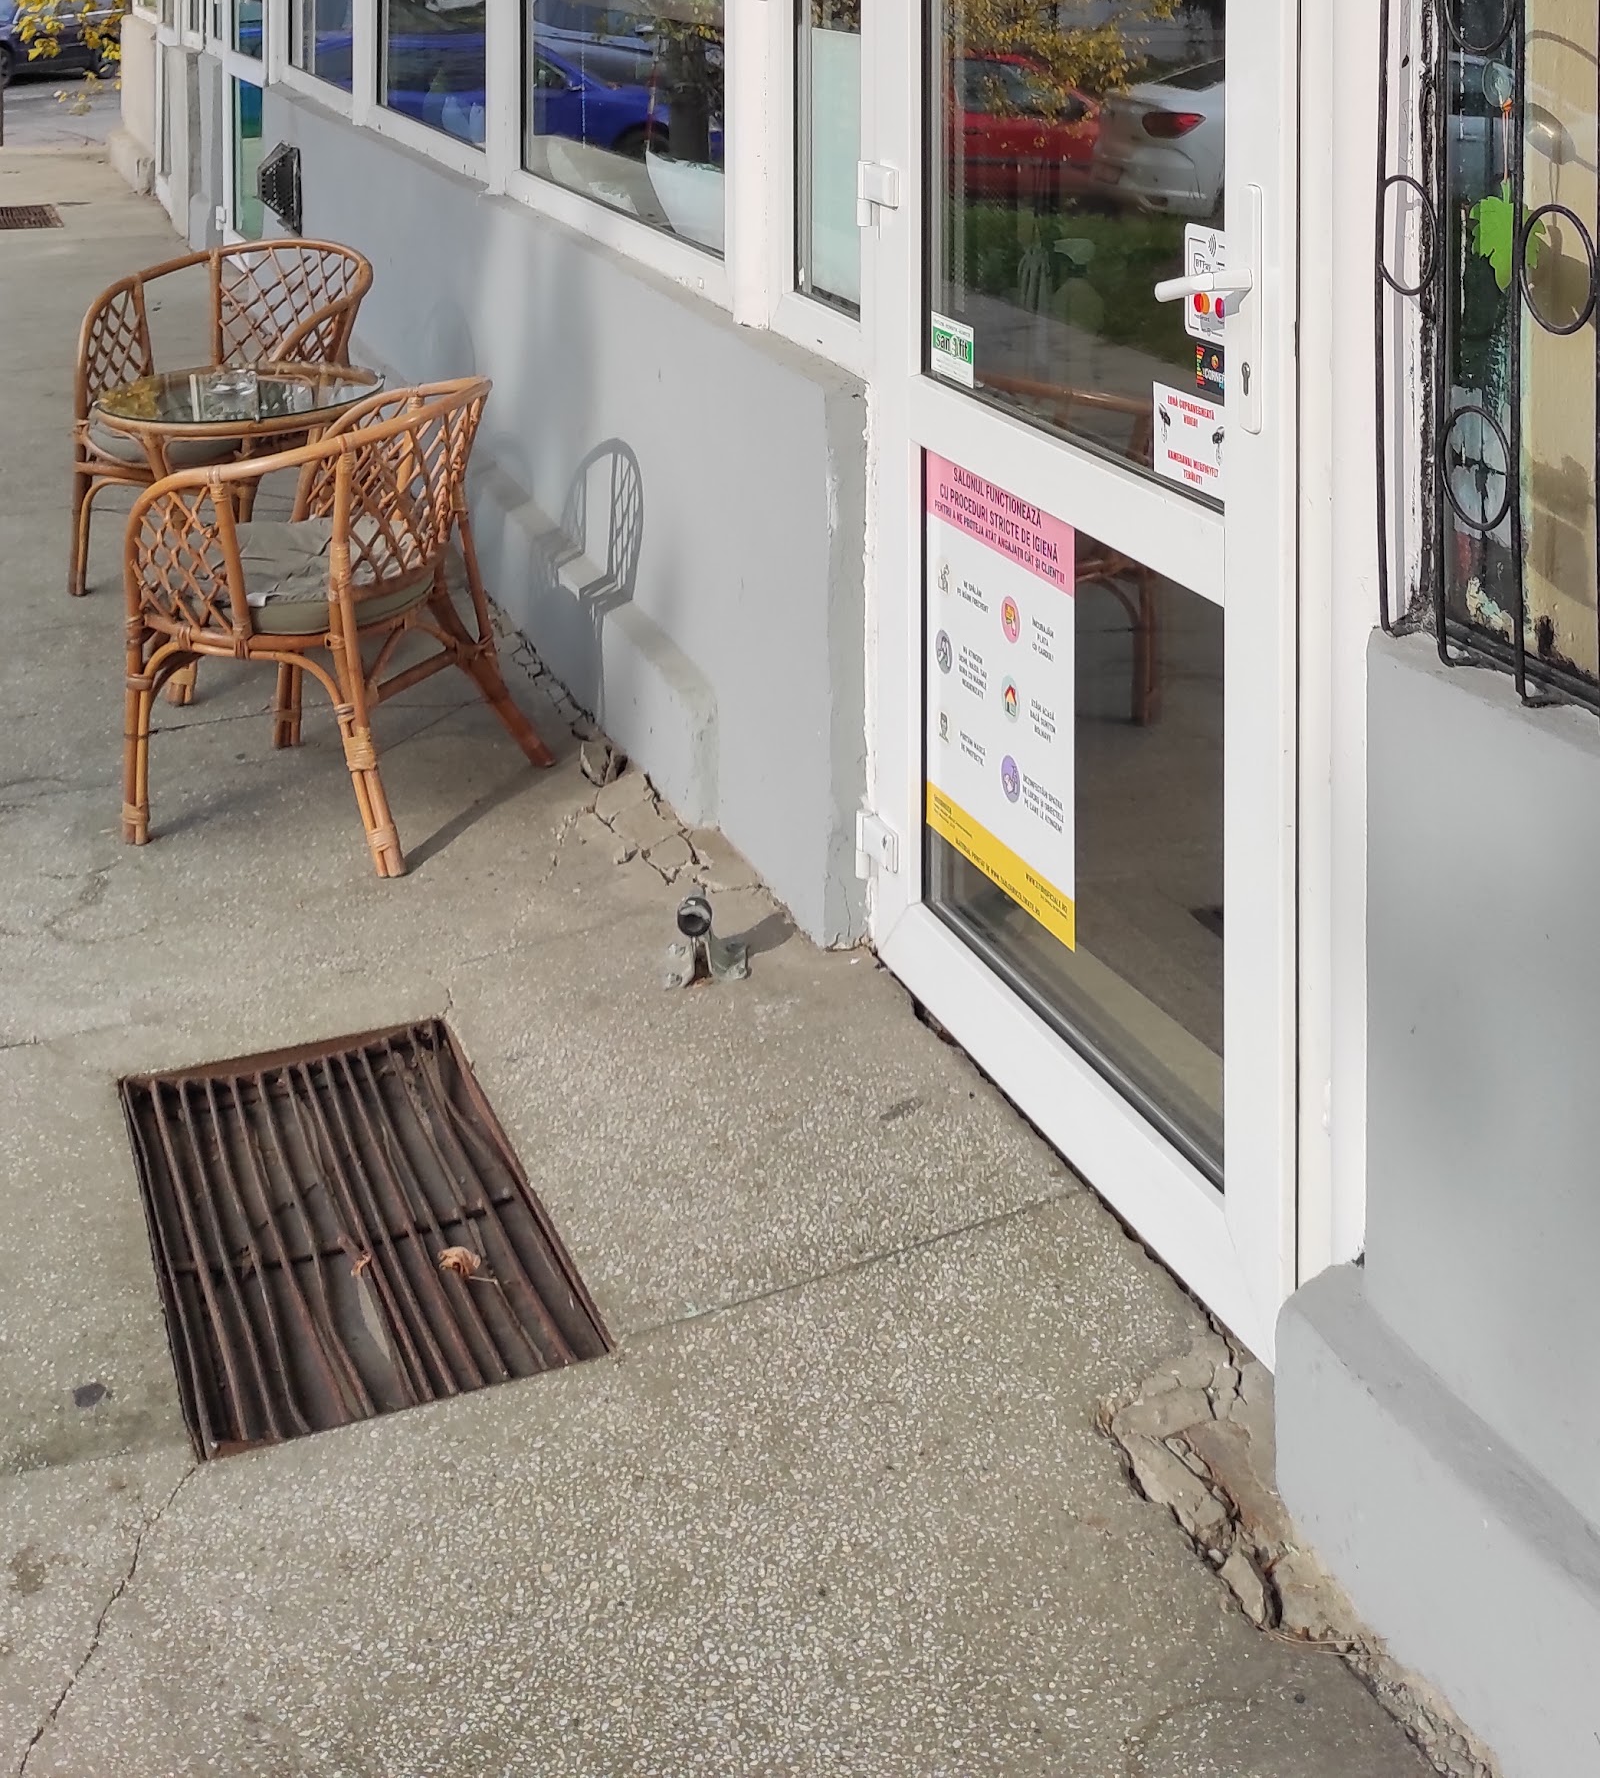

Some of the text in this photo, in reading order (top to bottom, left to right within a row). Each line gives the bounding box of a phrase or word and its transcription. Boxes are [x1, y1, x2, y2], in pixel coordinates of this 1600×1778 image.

[934, 499, 952, 519] PENTRU
[952, 509, 956, 519] A
[956, 512, 963, 525] NE
[964, 517, 984, 537] PROTEJA
[940, 483, 1058, 563] CU PROCEDURI STRICTE DE IGIENĂ
[953, 467, 1042, 529] SALONUL FUNCȚIONEAZĂ
